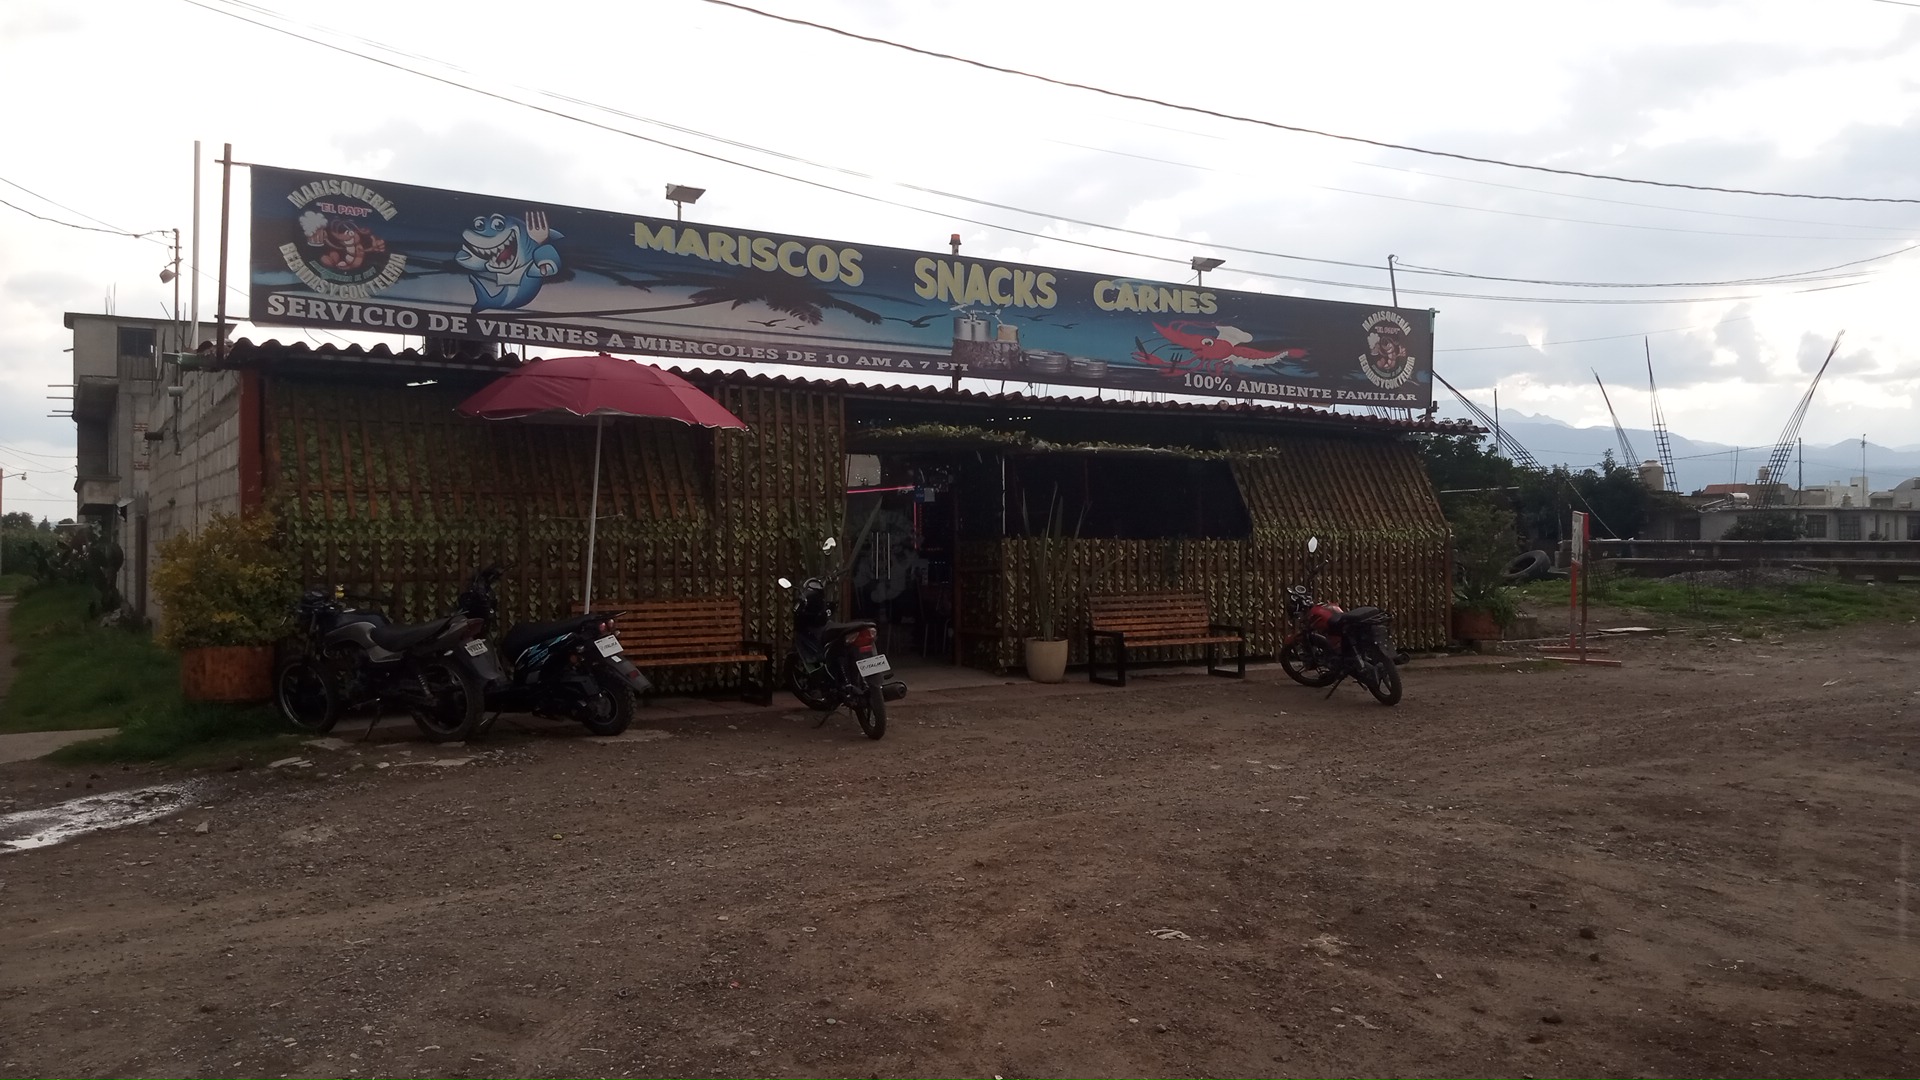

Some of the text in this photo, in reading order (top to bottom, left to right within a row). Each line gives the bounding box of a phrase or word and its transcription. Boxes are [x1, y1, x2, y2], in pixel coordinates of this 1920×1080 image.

[634, 222, 864, 287] MARISCOS
[914, 257, 1057, 309] SNACKS
[1093, 280, 1218, 315] CARNES
[267, 294, 420, 329] SERVICIO
[428, 314, 468, 334] DE
[476, 318, 599, 346] VIERNES
[608, 333, 626, 348] A
[633, 335, 780, 361] MIERCOLES
[786, 350, 819, 363] DE
[826, 353, 850, 365] 10
[855, 355, 893, 368] AM
[898, 359, 916, 370] A
[918, 360, 932, 370] 7
[1184, 373, 1417, 401] 100% AMBIENTE FAMILIAR
